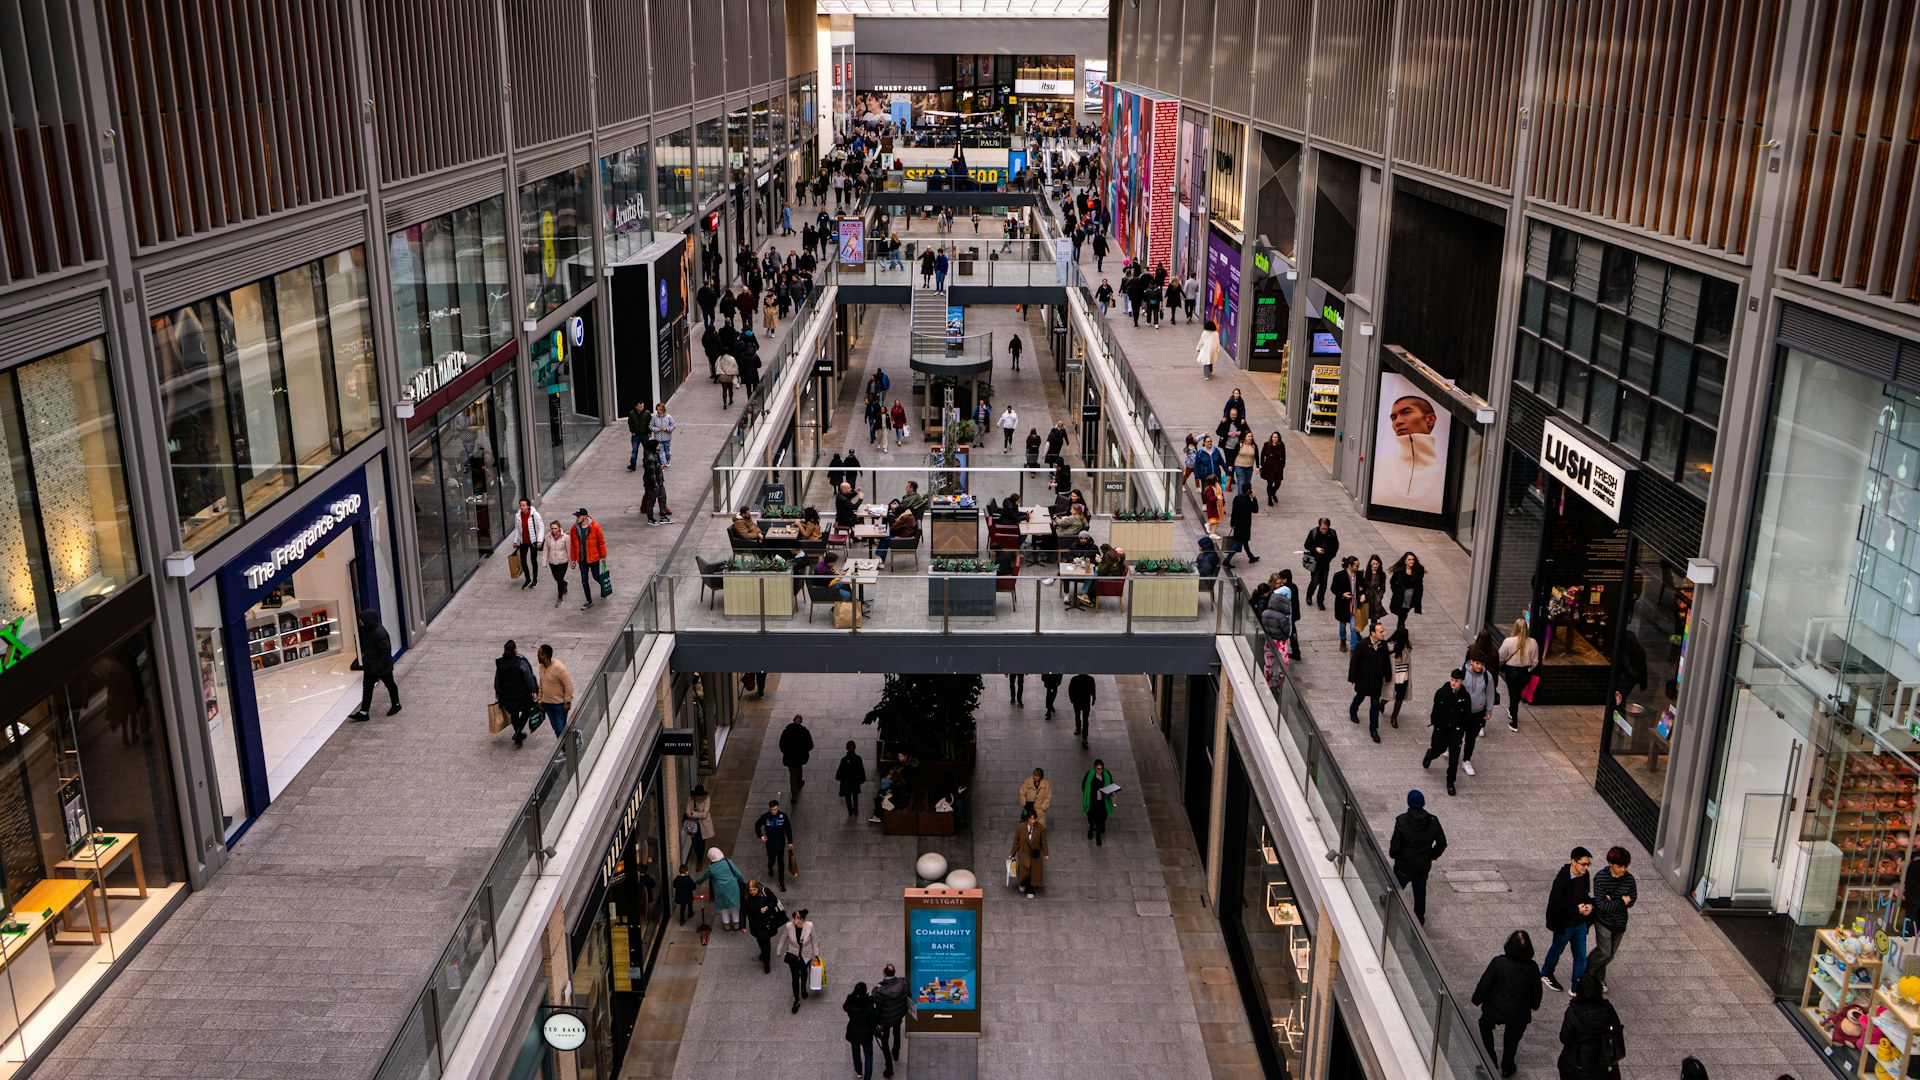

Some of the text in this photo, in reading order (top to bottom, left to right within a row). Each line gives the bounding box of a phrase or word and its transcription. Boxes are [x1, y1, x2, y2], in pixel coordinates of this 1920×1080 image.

[1041, 81, 1056, 91] itsu
[980, 139, 1000, 147] PAUL
[415, 368, 432, 402] PRET
[438, 350, 463, 387] MANGER
[1545, 433, 1593, 491] LUSH
[1592, 478, 1617, 500] HANDMADE
[1594, 465, 1618, 491] FRESH
[1591, 487, 1615, 508] COSMETICS
[249, 493, 361, 589] The Fragrance Shop
[915, 928, 972, 936] COMMUNITY
